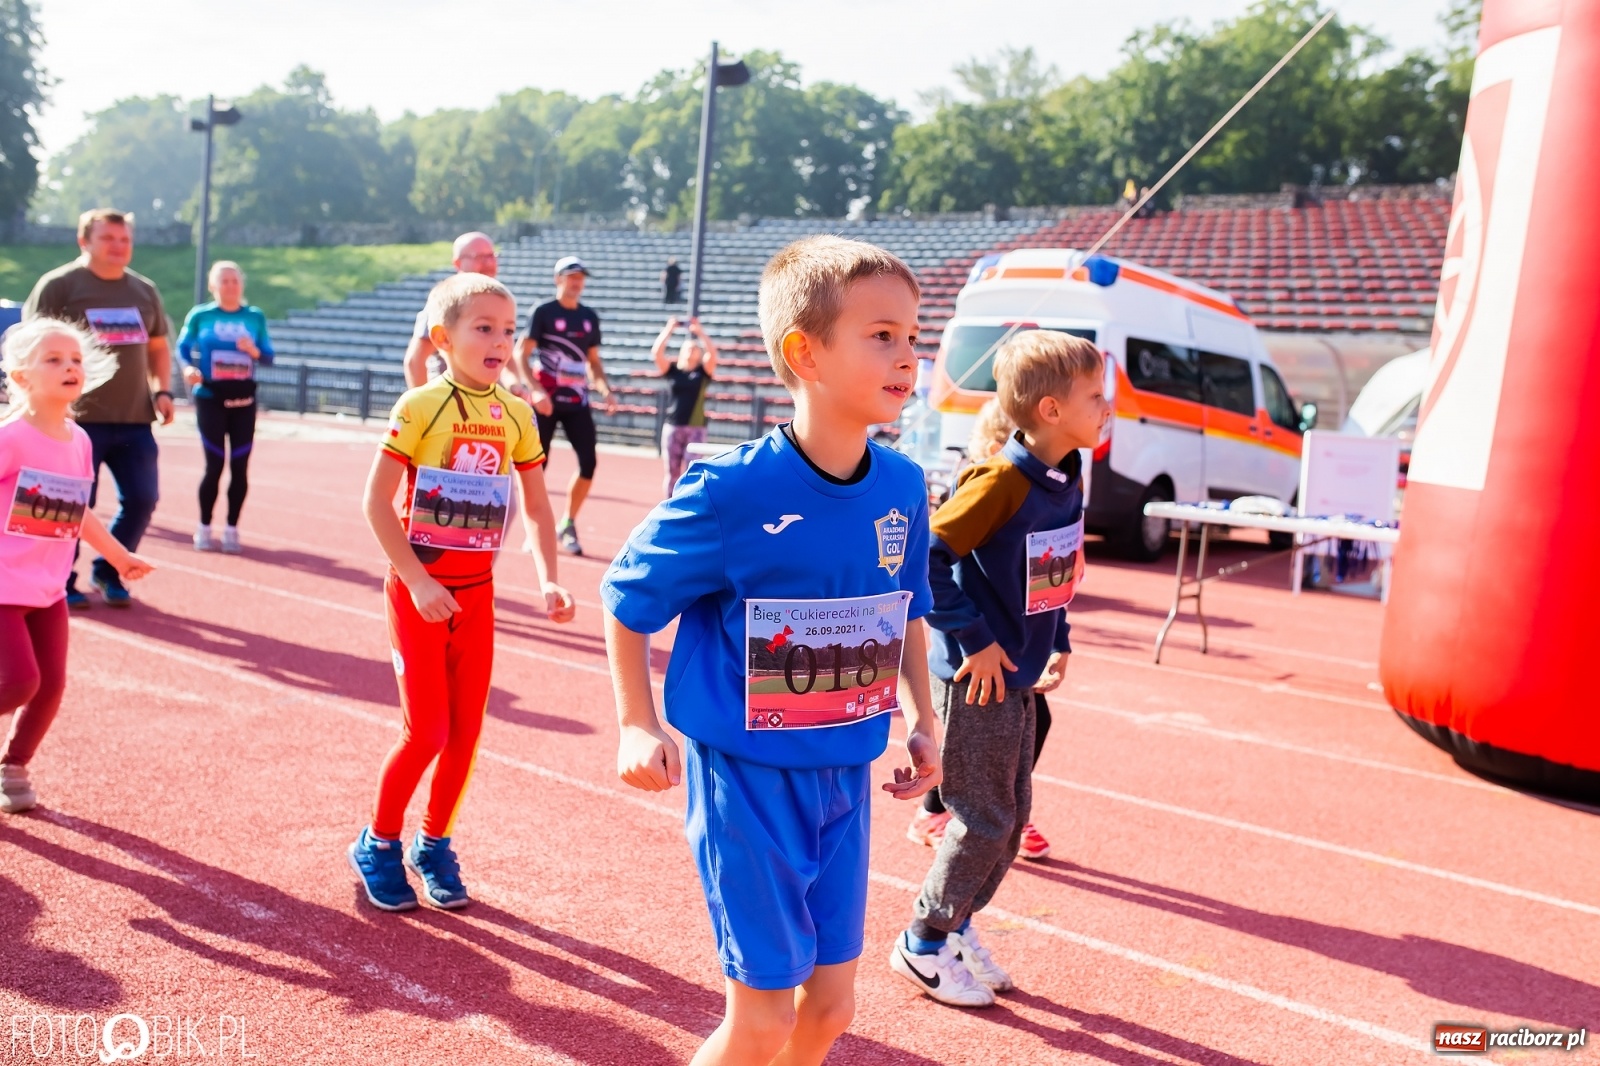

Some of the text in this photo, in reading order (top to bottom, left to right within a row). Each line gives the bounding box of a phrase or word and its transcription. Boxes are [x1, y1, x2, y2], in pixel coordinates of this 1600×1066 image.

[434, 497, 492, 530] 014
[886, 542, 901, 555] GOL
[753, 600, 902, 624] Bieg "Cukiereczki na Start"
[805, 625, 866, 636] 26.09.2021 r.
[784, 638, 879, 695] 018
